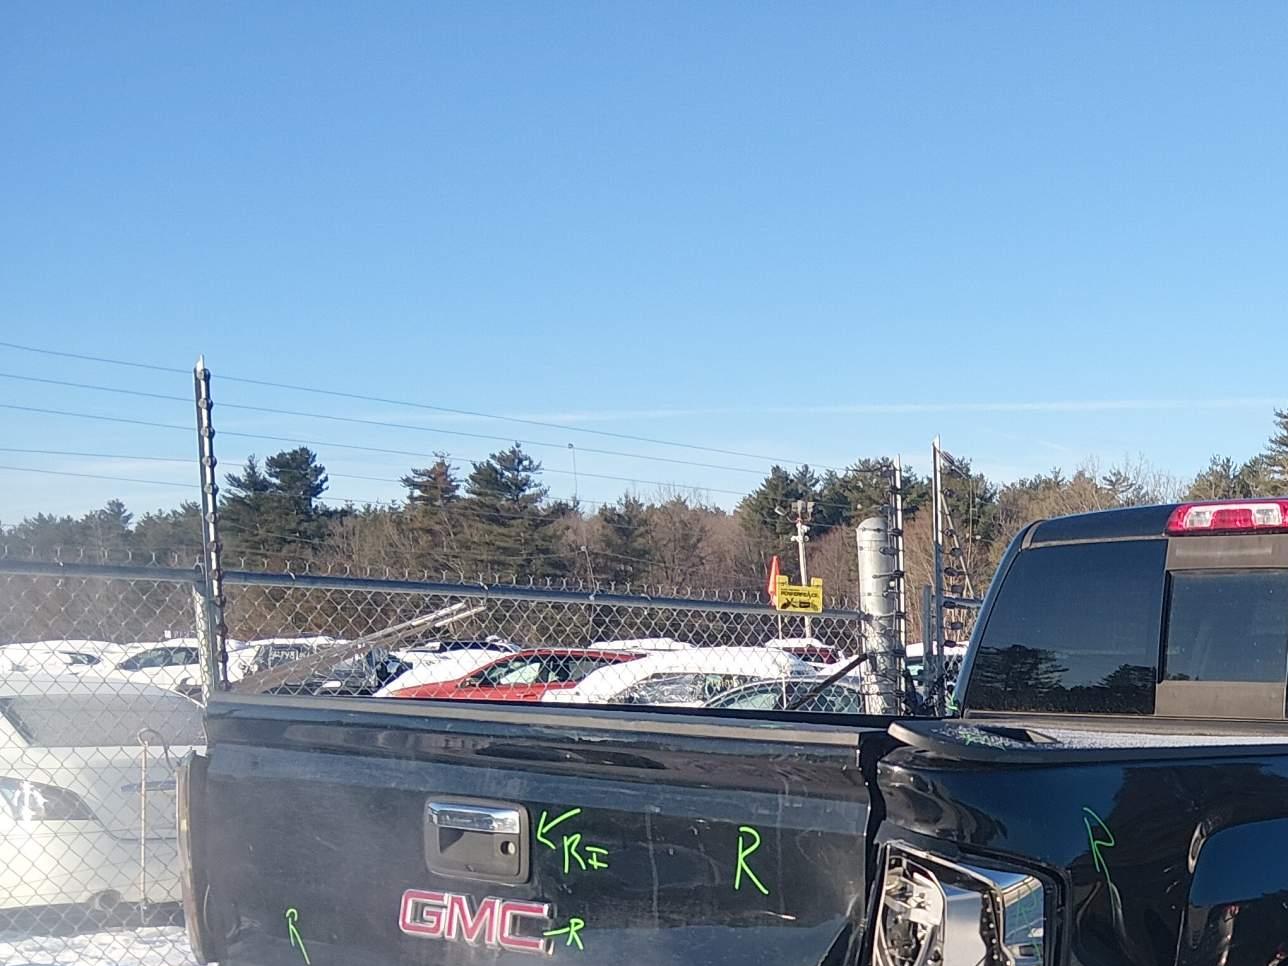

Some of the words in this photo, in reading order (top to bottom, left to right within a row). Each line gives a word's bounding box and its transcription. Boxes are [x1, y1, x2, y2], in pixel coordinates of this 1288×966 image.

[735, 826, 768, 895] R
[399, 888, 554, 954] GMC
[567, 917, 585, 950] R
